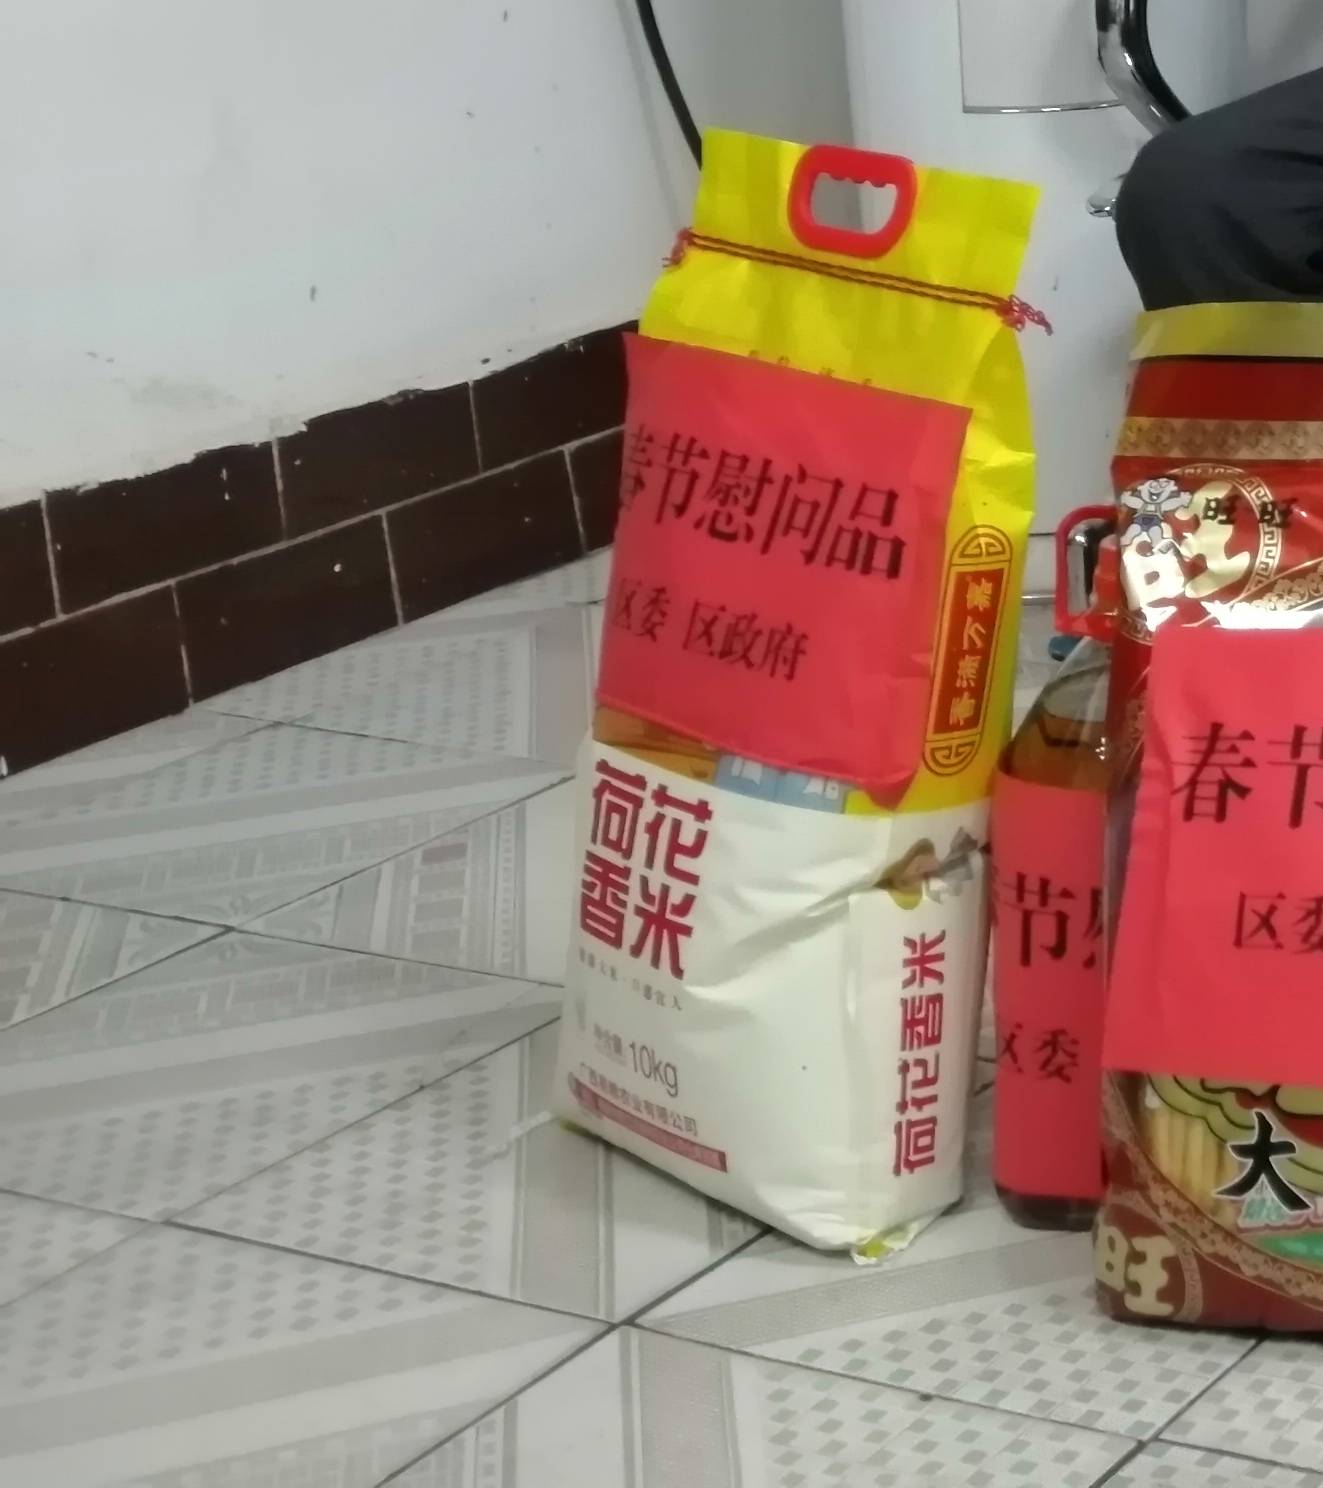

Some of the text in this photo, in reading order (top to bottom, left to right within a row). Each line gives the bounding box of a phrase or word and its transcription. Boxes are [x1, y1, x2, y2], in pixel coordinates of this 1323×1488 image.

[682, 598, 809, 681] 区政府
[590, 759, 714, 888] 荷花
[580, 849, 698, 981] 香米
[628, 1041, 679, 1098] 10kg
[893, 929, 947, 1177] 荷花香米
